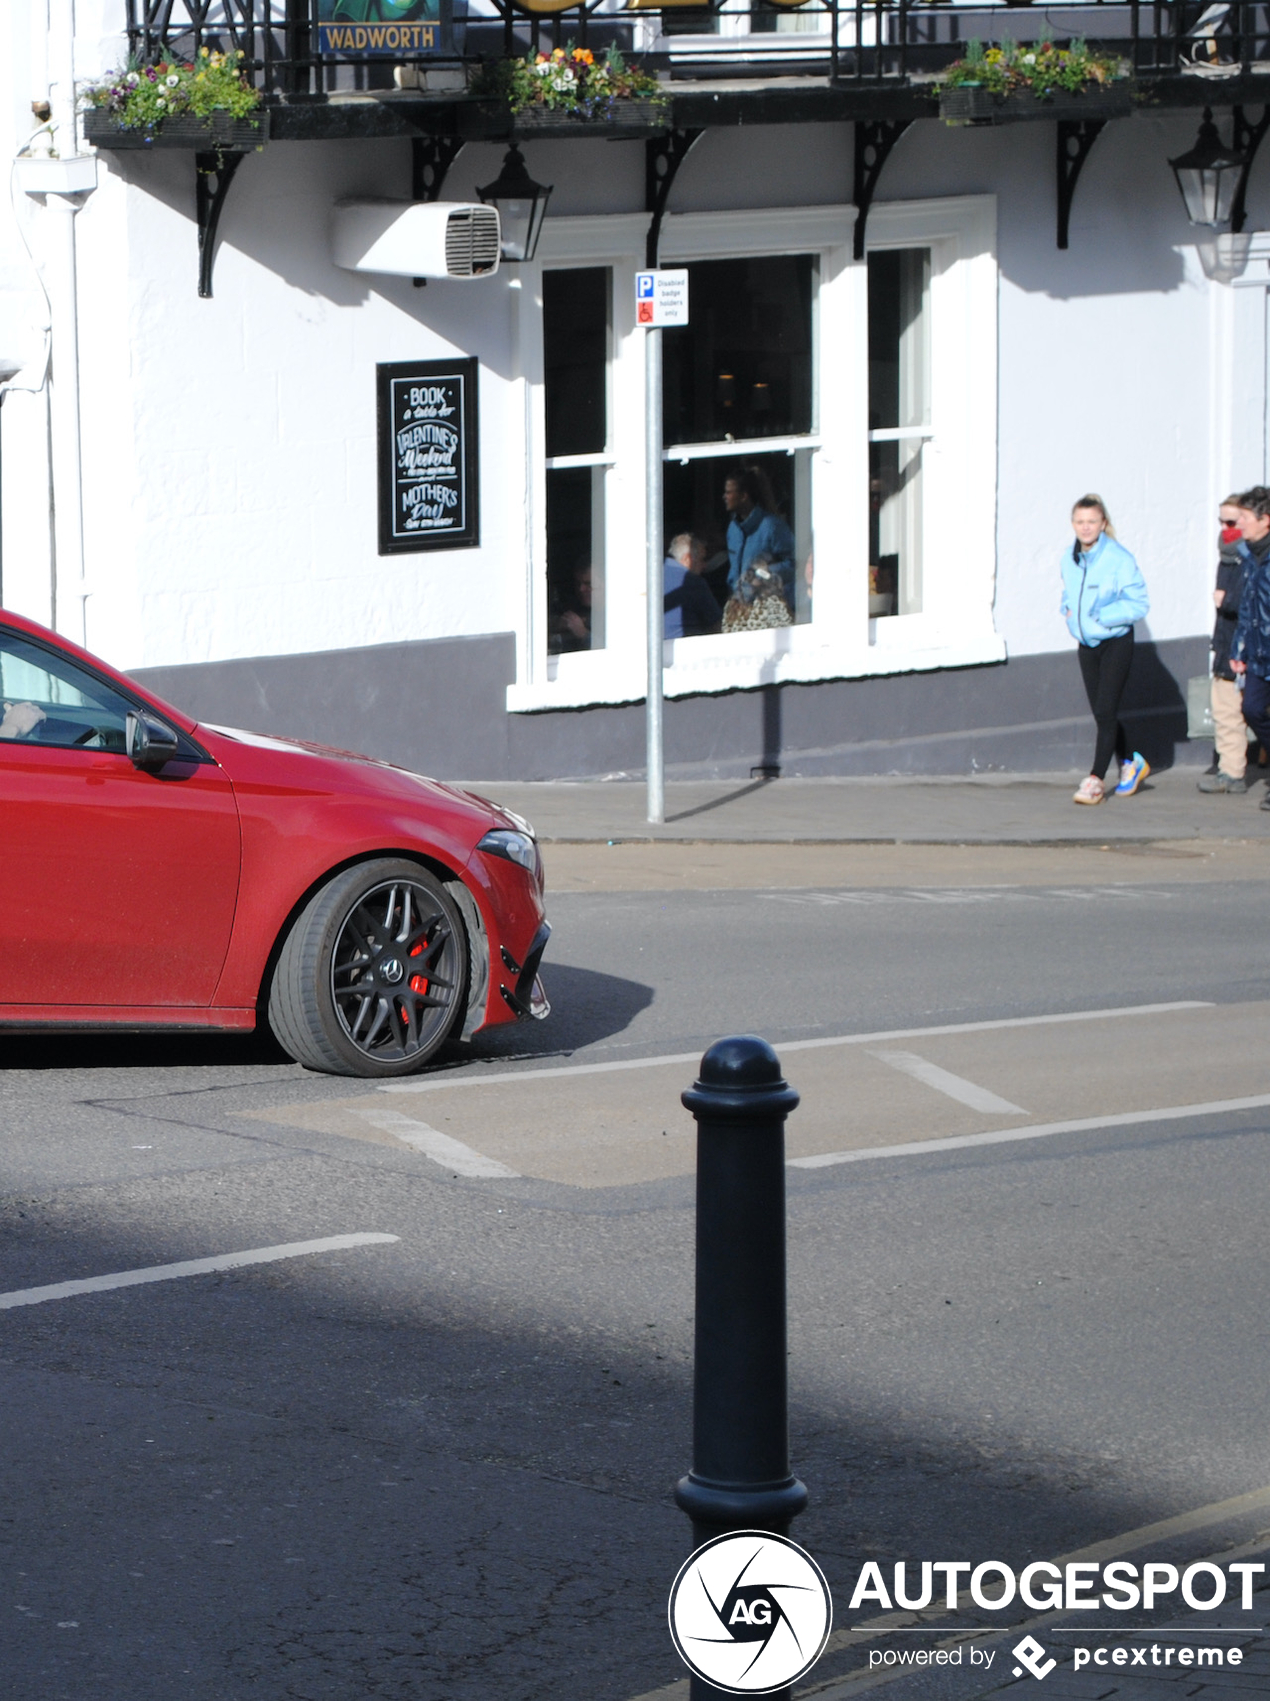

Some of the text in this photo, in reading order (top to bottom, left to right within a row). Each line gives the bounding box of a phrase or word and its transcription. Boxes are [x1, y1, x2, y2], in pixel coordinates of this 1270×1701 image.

[326, 26, 434, 49] WADWORTH
[640, 276, 652, 297] P
[658, 279, 685, 287] Disabled
[410, 387, 446, 407] BOOK
